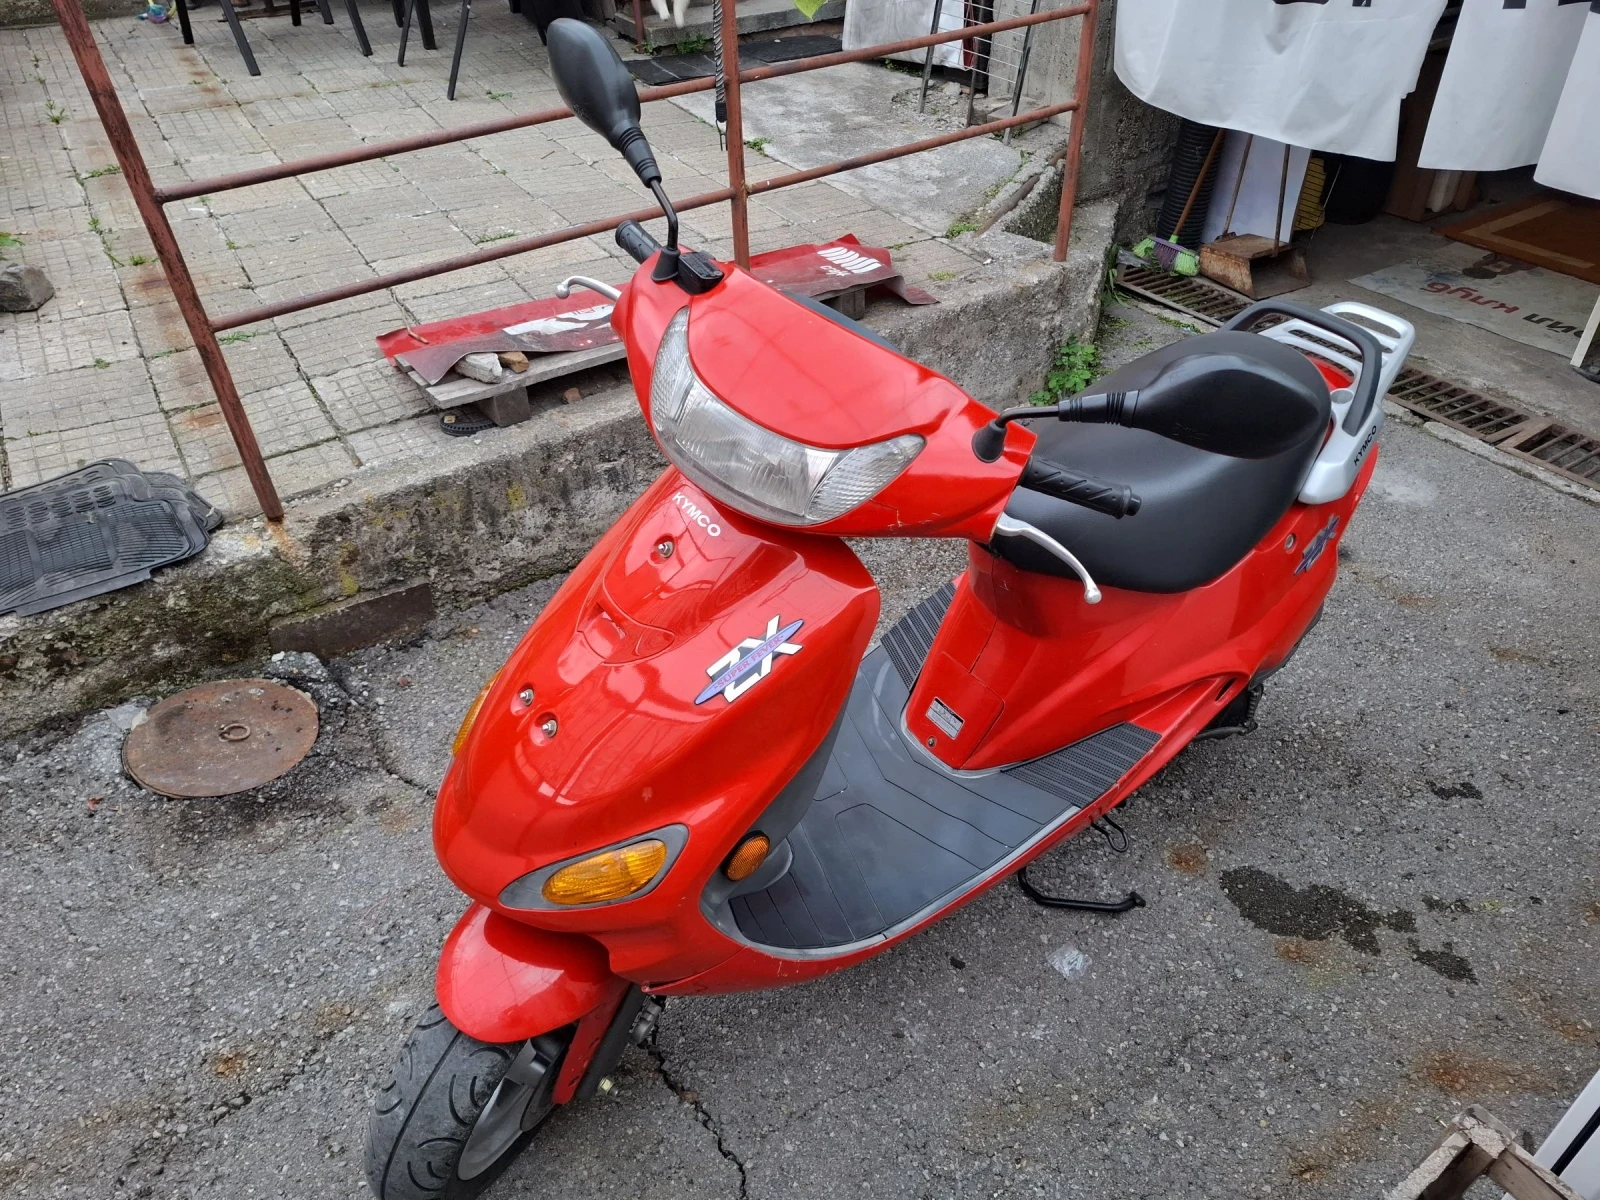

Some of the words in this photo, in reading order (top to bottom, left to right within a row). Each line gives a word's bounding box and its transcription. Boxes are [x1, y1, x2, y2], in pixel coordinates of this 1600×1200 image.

[1420, 281, 1520, 314] клуб
[1354, 425, 1377, 466] KYMCO
[672, 491, 721, 537] KYMCO
